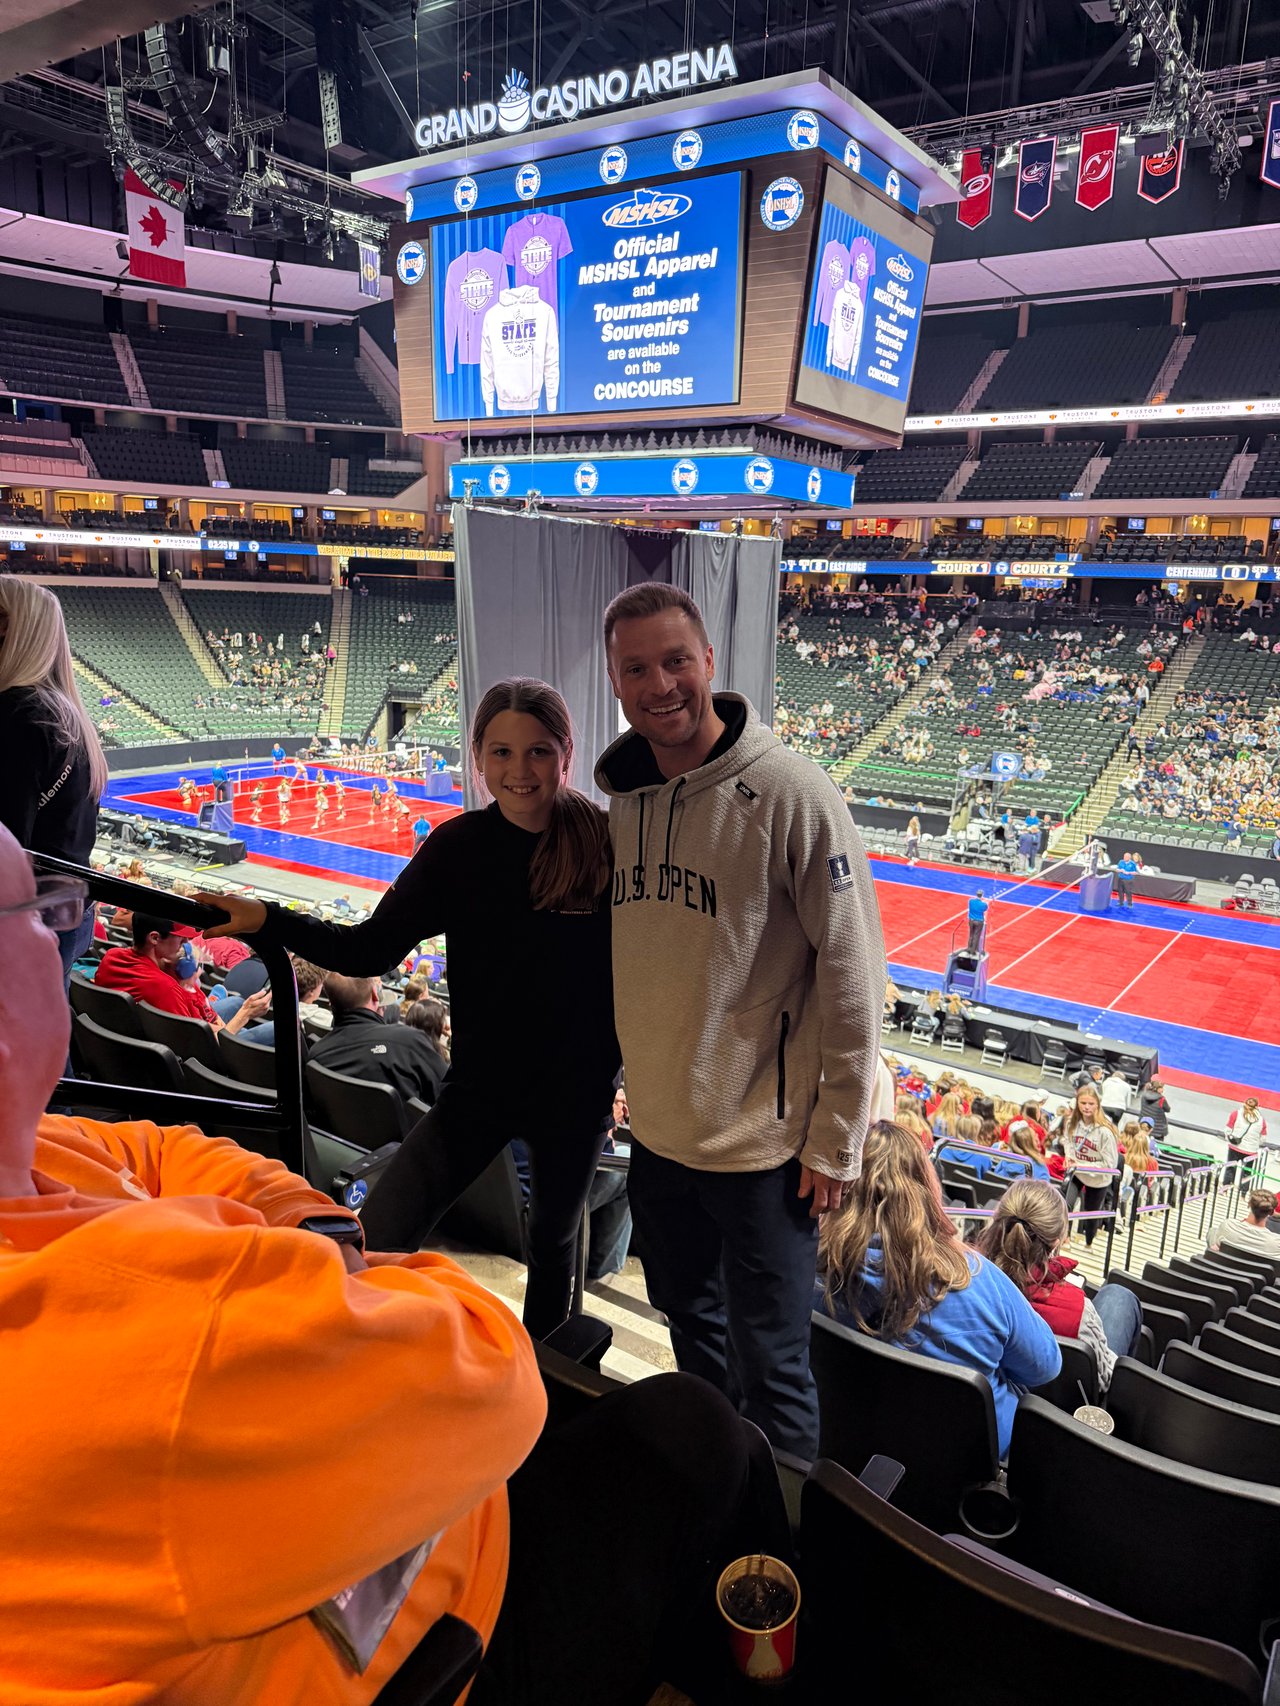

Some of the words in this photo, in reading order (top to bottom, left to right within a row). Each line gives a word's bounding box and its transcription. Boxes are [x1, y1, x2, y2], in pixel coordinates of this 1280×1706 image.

[416, 103, 497, 147] GRAND
[531, 70, 629, 119] CASINO
[632, 44, 738, 97] ARENA
[607, 198, 679, 225] MSHSL
[613, 231, 680, 260] Official
[578, 259, 640, 285] MSHSL
[643, 247, 718, 279] Apparel
[632, 281, 655, 297] and
[887, 280, 908, 301] Official
[593, 293, 700, 322] Tournament
[894, 298, 917, 319] Apparel
[502, 322, 536, 340] STATE
[601, 316, 689, 342] Souvenirs
[875, 314, 908, 341] Tournament
[607, 348, 626, 361] are
[628, 341, 680, 358] available
[624, 363, 640, 375] on
[642, 360, 661, 374] the
[594, 377, 694, 400] CONCOURSE
[937, 563, 980, 573] COURT
[980, 563, 988, 573] 1
[1012, 564, 1058, 574] COURT
[1059, 565, 1069, 574] 2
[1166, 567, 1217, 578] CENTENNIAL
[1231, 567, 1239, 578] 0
[38, 764, 72, 810] ulemon
[612, 864, 650, 906] U.S.
[657, 863, 717, 918] OPEN
